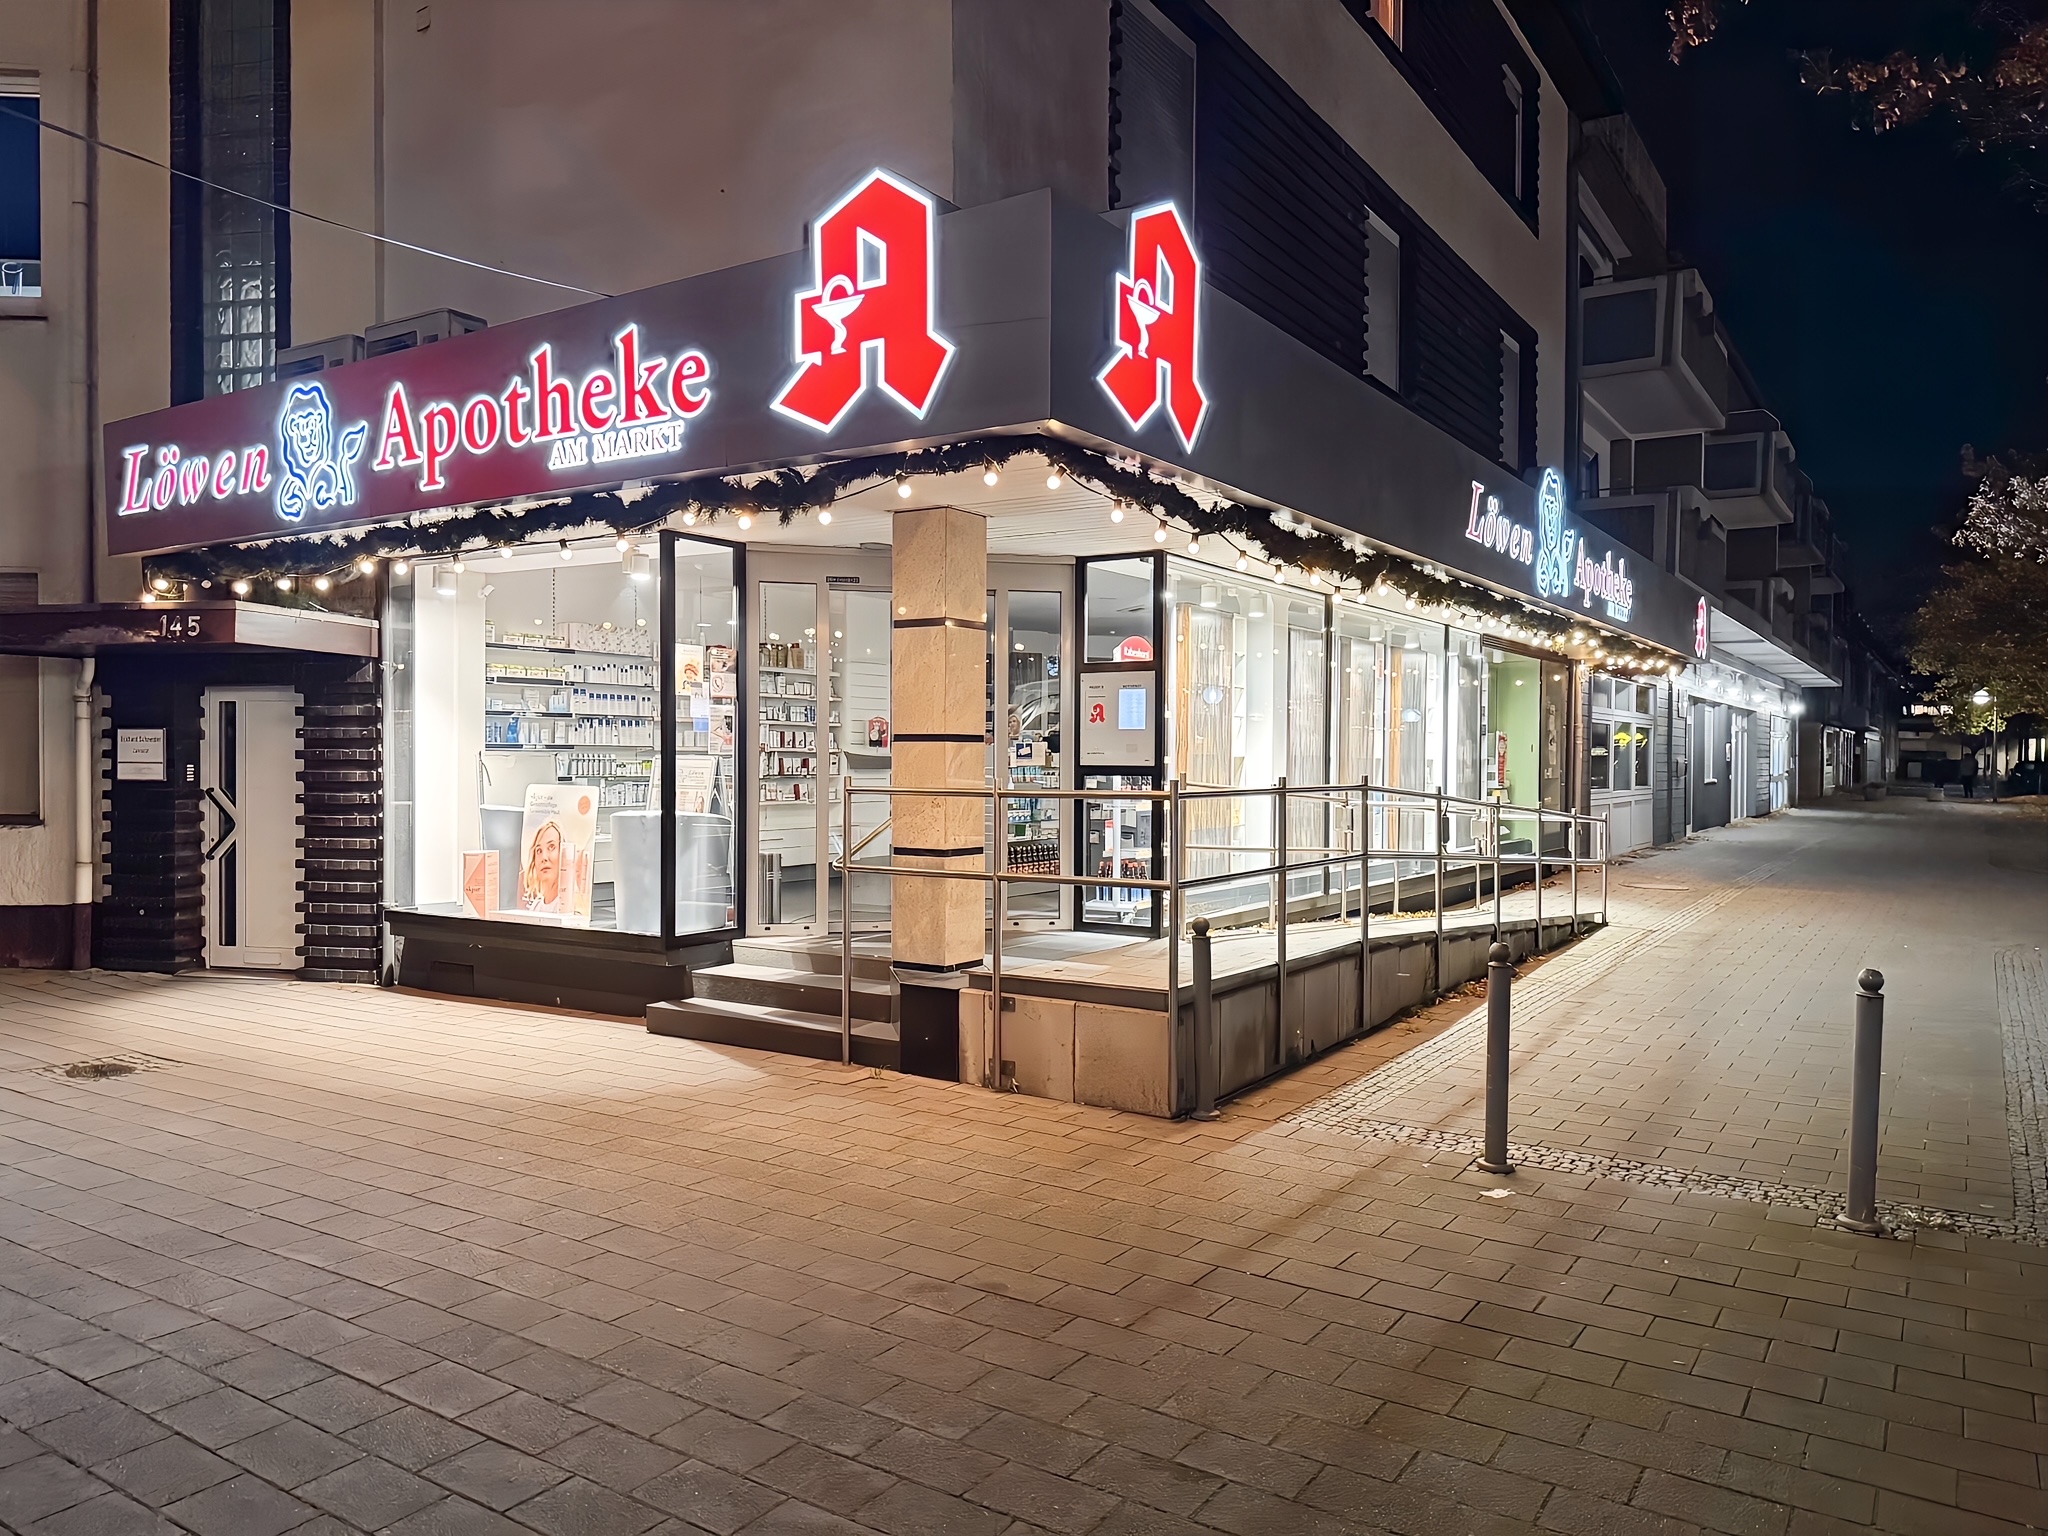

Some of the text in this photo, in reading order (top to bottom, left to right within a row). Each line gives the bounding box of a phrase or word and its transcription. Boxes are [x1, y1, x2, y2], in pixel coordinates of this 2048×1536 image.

[118, 323, 711, 517] Löwen Apotheke
[549, 420, 684, 470] AM MARKT
[1465, 480, 1633, 609] Löwen Apotheke
[160, 614, 201, 637] 145
